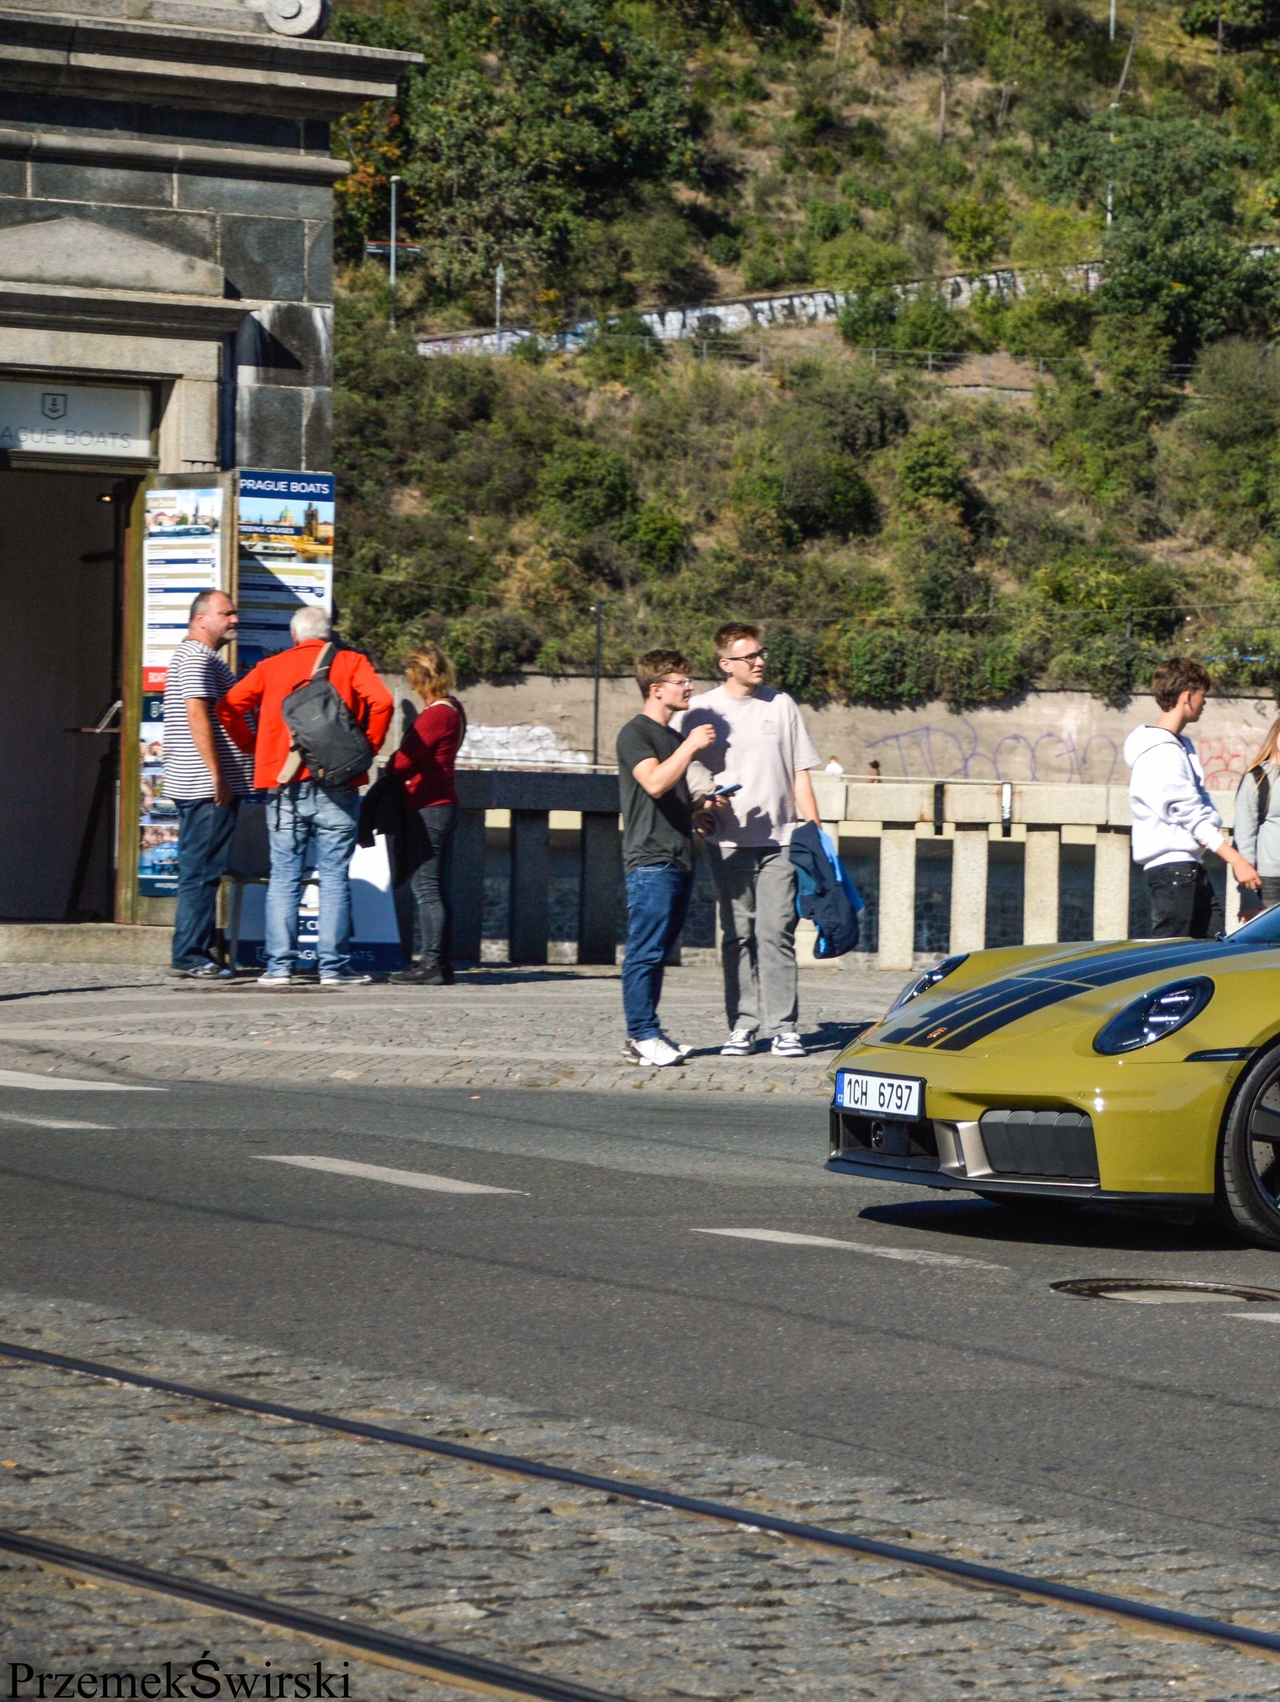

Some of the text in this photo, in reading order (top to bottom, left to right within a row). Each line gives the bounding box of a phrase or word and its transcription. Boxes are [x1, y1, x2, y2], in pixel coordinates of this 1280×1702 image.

[0, 426, 132, 449] AGUE BOATS
[239, 478, 330, 495] PRAGUE BOATS
[847, 1077, 913, 1111] 1CH 6797
